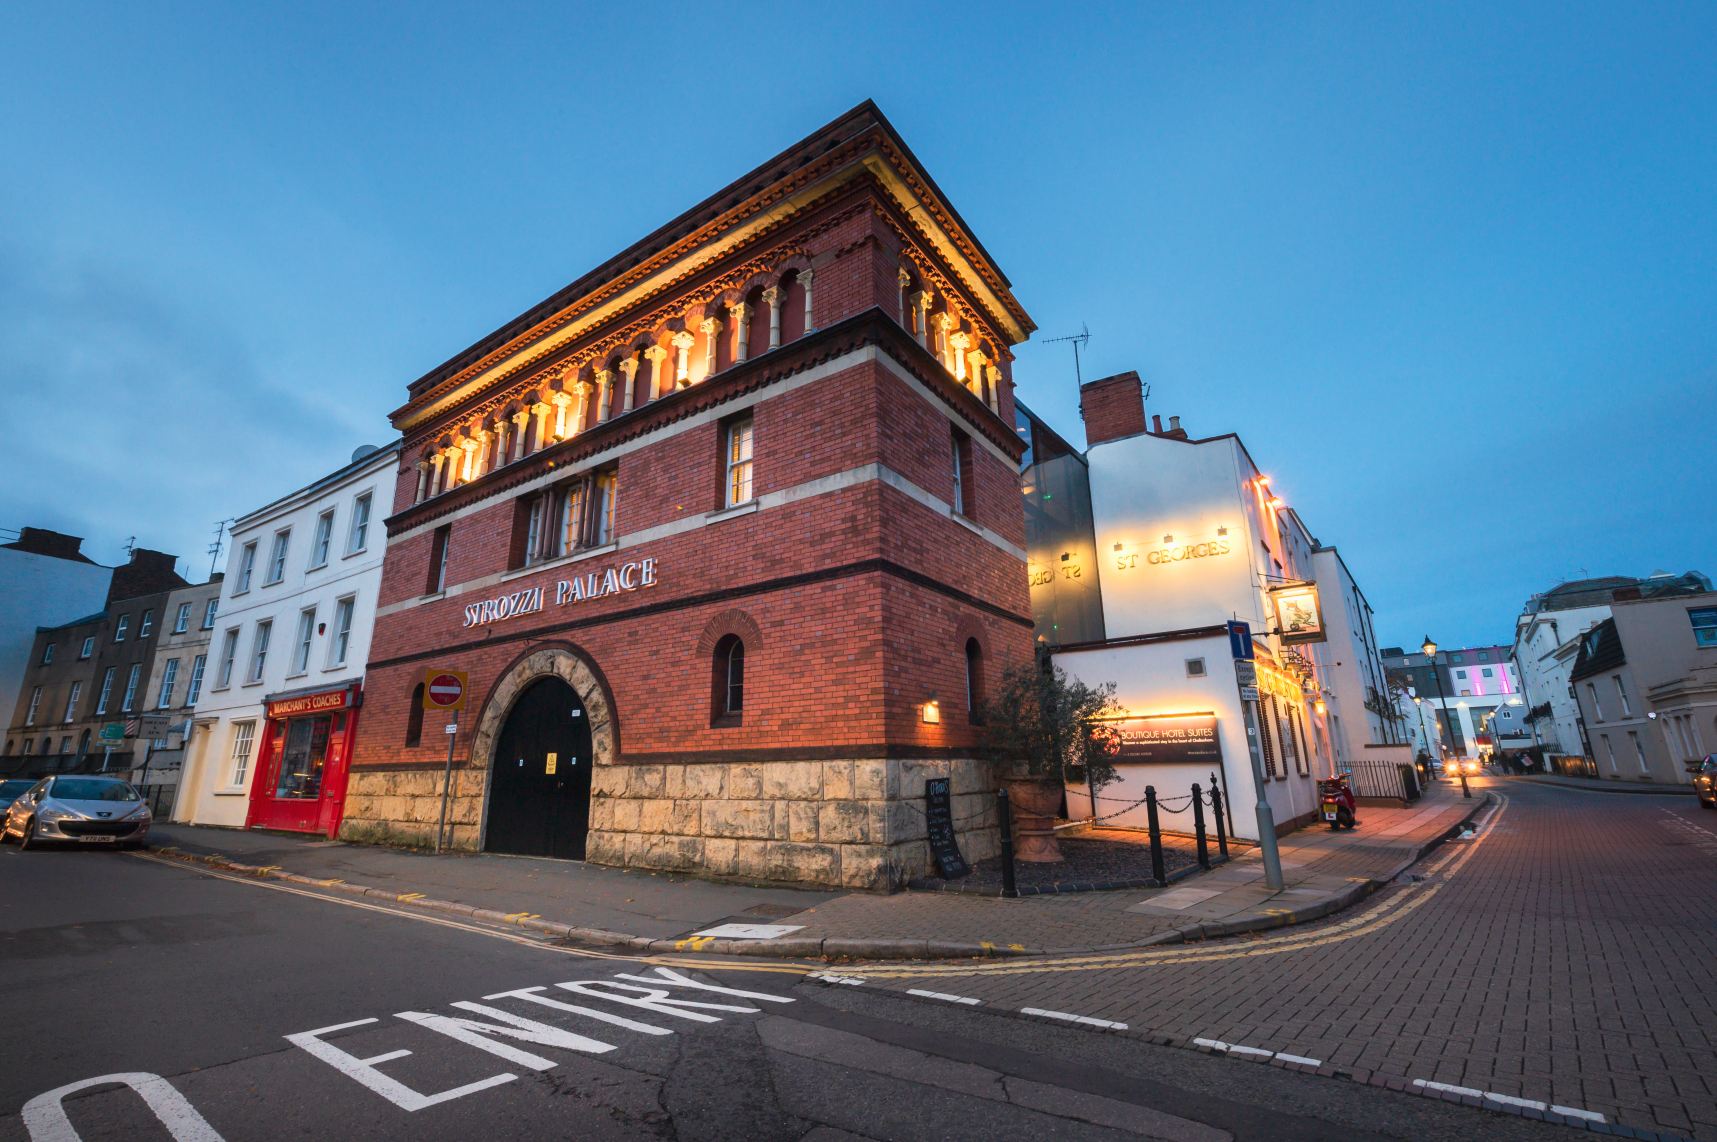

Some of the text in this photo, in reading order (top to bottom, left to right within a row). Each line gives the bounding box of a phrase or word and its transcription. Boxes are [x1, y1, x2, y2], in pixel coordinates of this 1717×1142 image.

[1117, 540, 1231, 570] ST GEORGES
[463, 558, 658, 628] STROZZI PALACE
[274, 693, 341, 714] MARCHANT'S COACHES
[1121, 728, 1213, 740] BOUTIQUE HOTEL SUITES
[284, 967, 796, 1112] ENTRY
